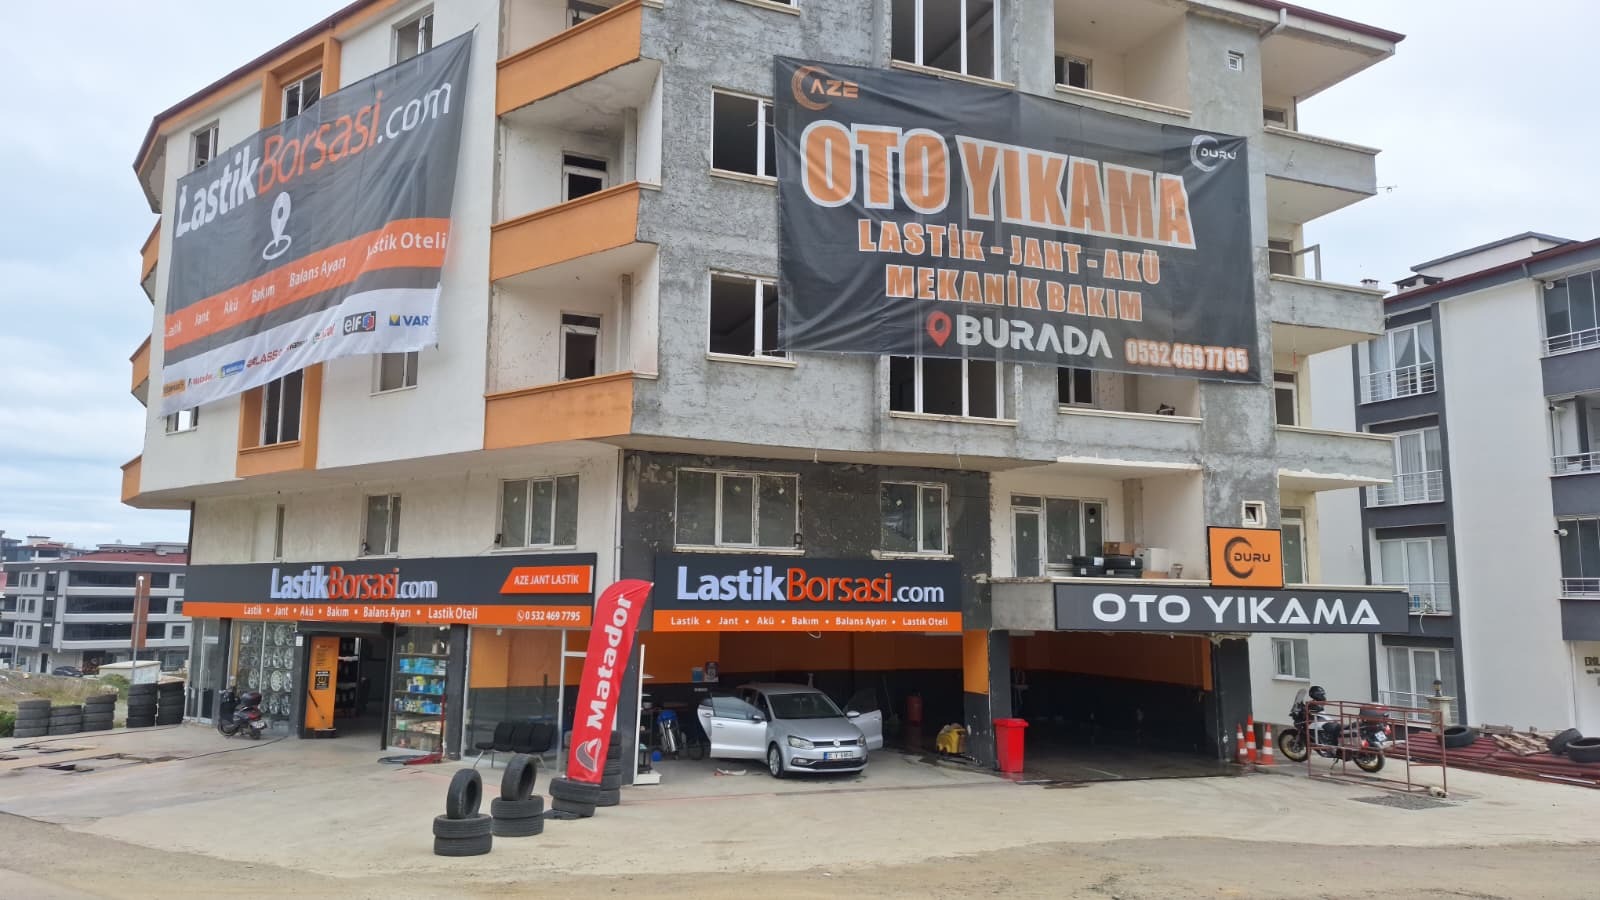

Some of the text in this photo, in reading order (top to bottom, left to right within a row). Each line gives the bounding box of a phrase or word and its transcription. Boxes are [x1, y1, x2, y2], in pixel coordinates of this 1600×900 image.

[176, 82, 451, 238] LastikBorsasi.com
[1200, 147, 1237, 160] DURU
[799, 119, 1196, 250] OTO YIKAMA
[289, 266, 319, 287] Balans
[400, 231, 448, 249] Oteli
[857, 218, 986, 262] LASTİK
[1009, 235, 1081, 274] JANT
[1103, 248, 1160, 284] AKÜ
[885, 263, 1143, 322] MEKANİK BAKIM
[344, 315, 361, 333] elf
[956, 314, 1113, 359] BURADA
[1234, 552, 1271, 562] DURU
[270, 566, 438, 600] LastikBorsasi.com
[514, 575, 529, 585] AZE
[530, 575, 550, 585] JANT
[677, 565, 945, 603] LastikBorsasi.com
[244, 604, 478, 620] Lastik Jant Akü Bakım Balans Ayarı Lastik Oteli
[531, 611, 545, 620] 532
[546, 611, 560, 620] 469
[561, 611, 581, 621] 7795
[671, 616, 948, 627] Lastik Jant Akü Bakım Balans Ayarı Lastik Oteli
[1092, 593, 1381, 625] OTO YIKAMA
[586, 594, 632, 730] Matador
